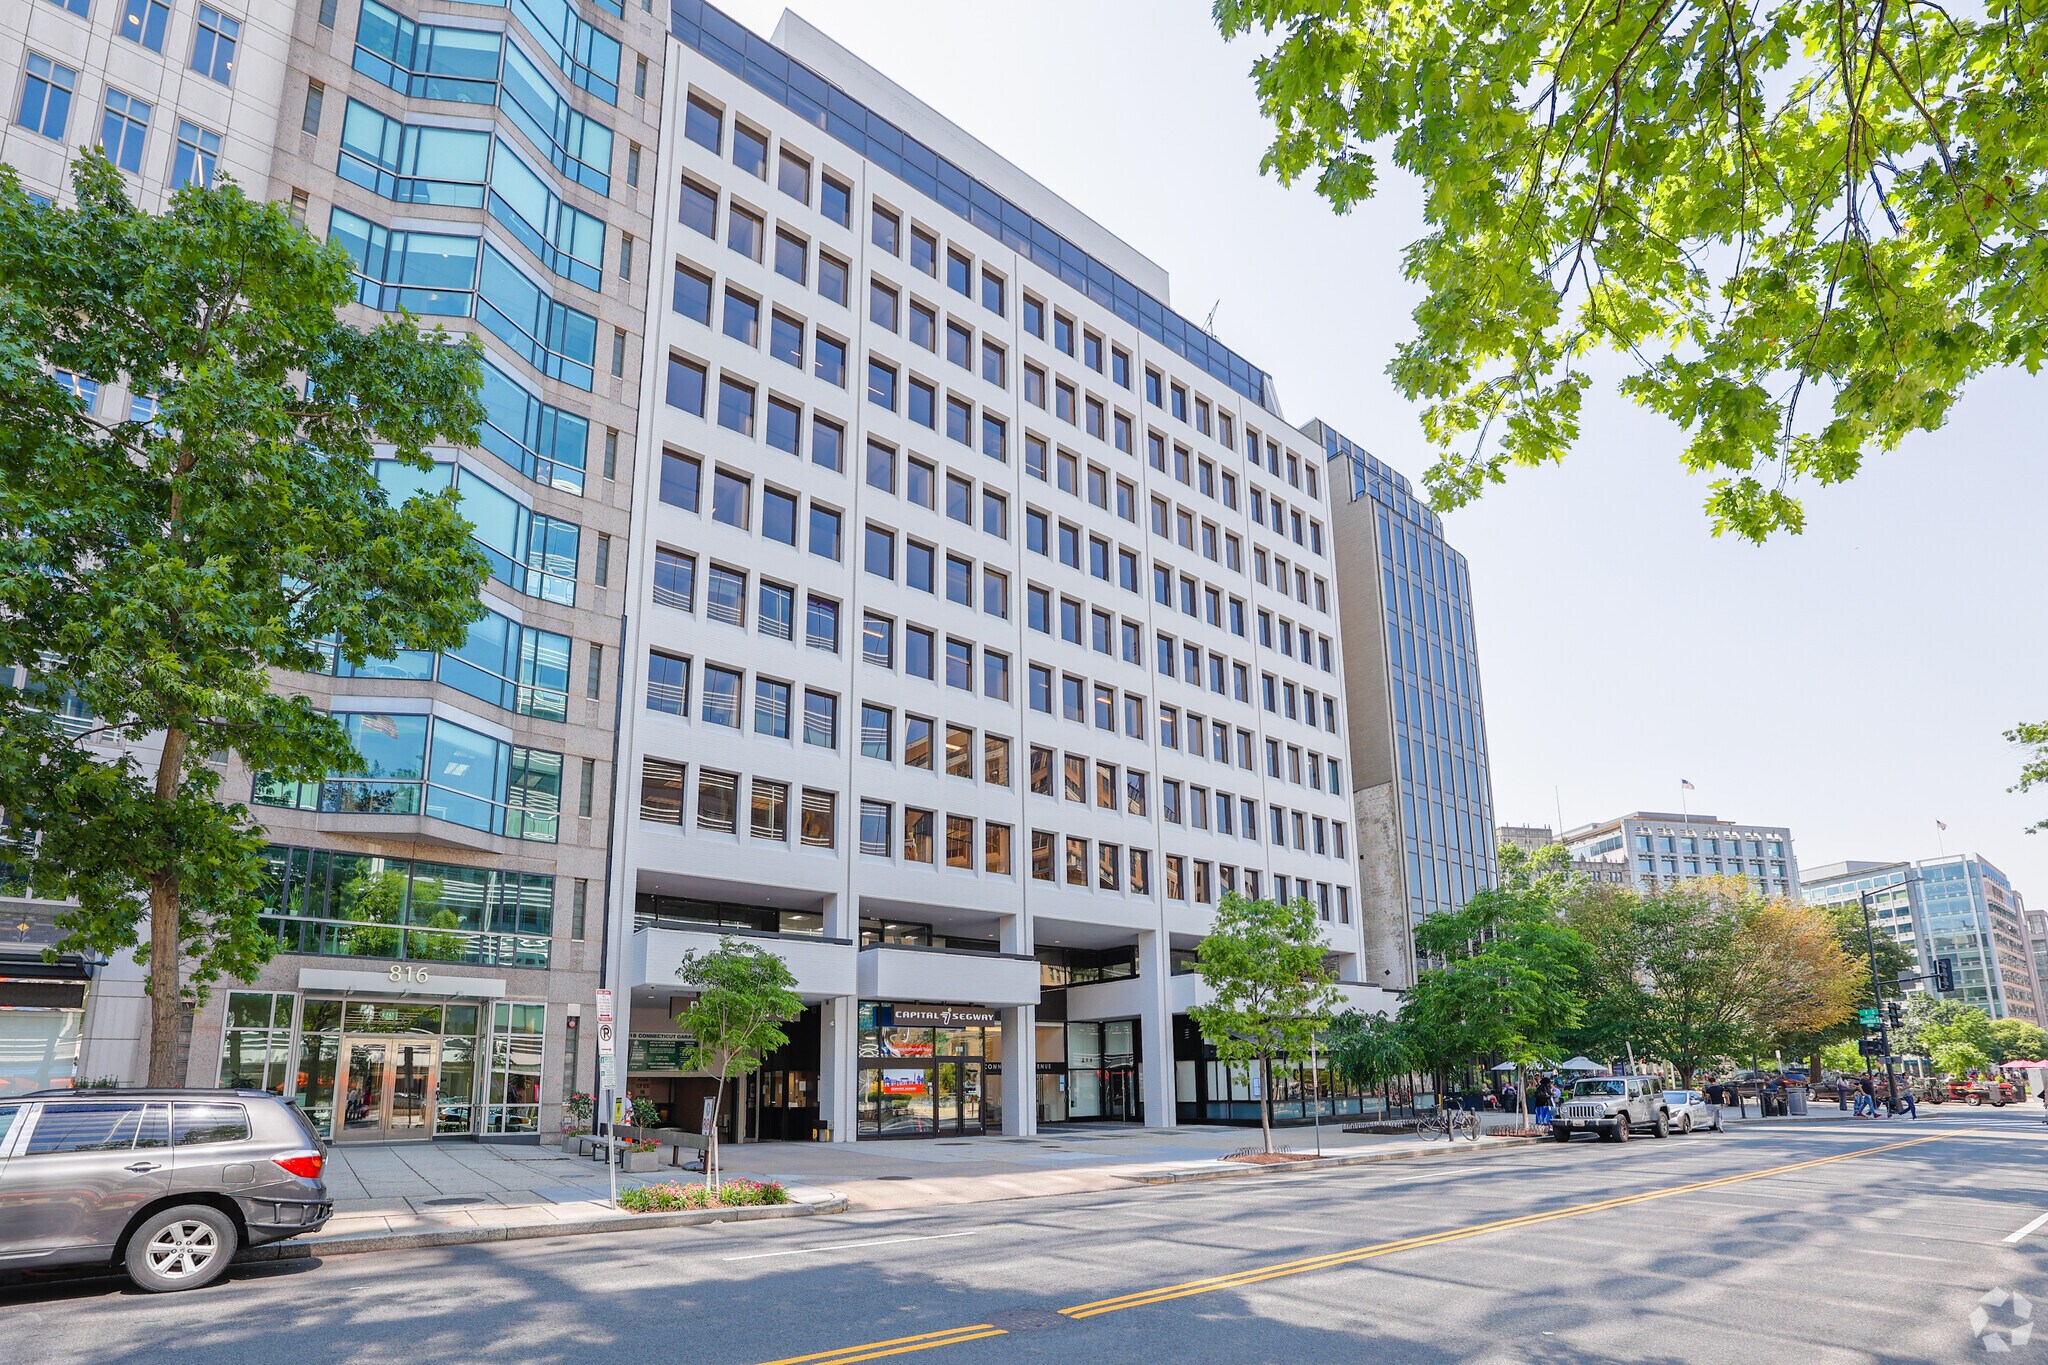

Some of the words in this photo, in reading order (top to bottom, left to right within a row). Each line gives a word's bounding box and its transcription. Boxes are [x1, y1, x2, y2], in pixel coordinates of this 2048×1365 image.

[389, 965, 429, 983] 816
[895, 1010, 940, 1020] CAPITAL
[952, 1013, 994, 1021] SEGWAY
